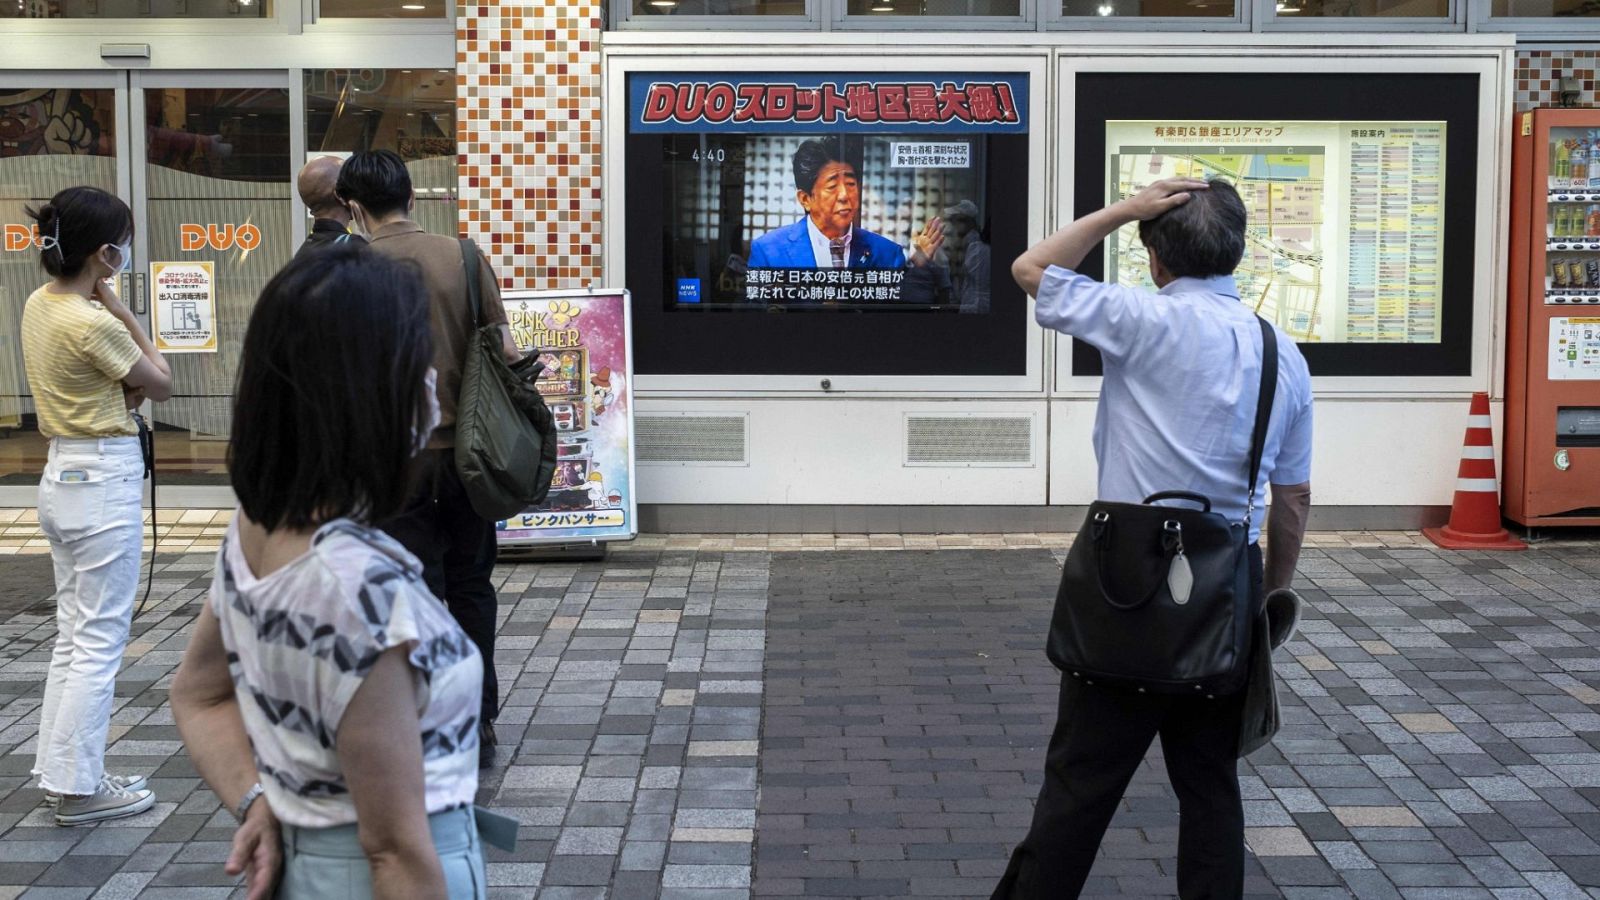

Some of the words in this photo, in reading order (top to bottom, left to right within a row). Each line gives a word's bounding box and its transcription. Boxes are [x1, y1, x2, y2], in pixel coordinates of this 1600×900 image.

[1155, 126, 1284, 136] 有楽町&銀座エリアマップ
[1351, 129, 1386, 138] 施設案内
[692, 149, 725, 162] 4:40
[180, 223, 261, 251] DUO
[746, 270, 784, 283] 速報だ
[789, 270, 904, 284] 日本の安倍元首相が
[746, 286, 900, 300] 撃たれて心肺停止の状態だ
[506, 310, 548, 331] PINK
[512, 328, 581, 350] ANTHER
